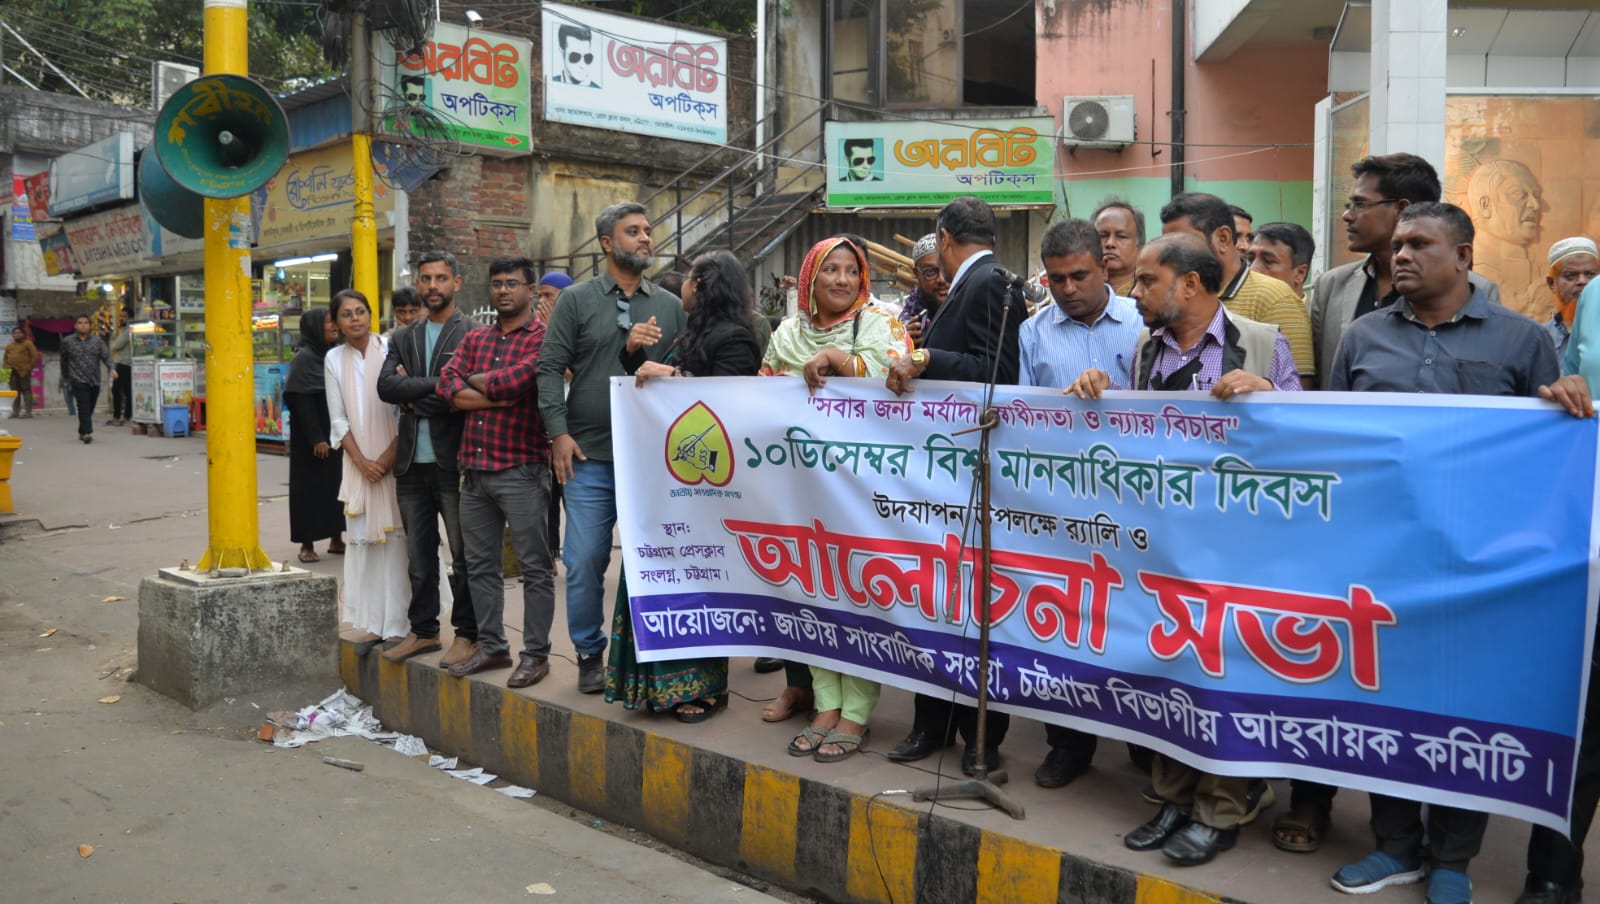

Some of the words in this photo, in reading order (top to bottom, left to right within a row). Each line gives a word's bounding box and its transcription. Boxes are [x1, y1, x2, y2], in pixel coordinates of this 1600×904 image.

[398, 37, 519, 88] অরবিট
[608, 40, 719, 93] অরবিট
[894, 127, 1037, 170] অরবিট
[873, 399, 915, 422] জন্য
[920, 394, 978, 425] মর্যাদা
[1083, 412, 1101, 431] ও
[1106, 412, 1155, 438] ন্যায়
[998, 444, 1203, 509] মানবাধিকার
[1211, 456, 1337, 519] দিবস
[873, 491, 966, 528] উদযাপন
[1128, 527, 1149, 550] ও
[637, 543, 674, 559] চট্টগ্রাম
[680, 544, 725, 559] প্রেসক্লাব
[721, 517, 1124, 655] আলোচনা
[1137, 569, 1397, 692] সভা
[771, 609, 839, 649] জাতীয়
[842, 621, 937, 675] সাংবাদিক
[1017, 658, 1101, 711] চট্টগ্রাম
[1106, 677, 1222, 746] বিভাগীয়
